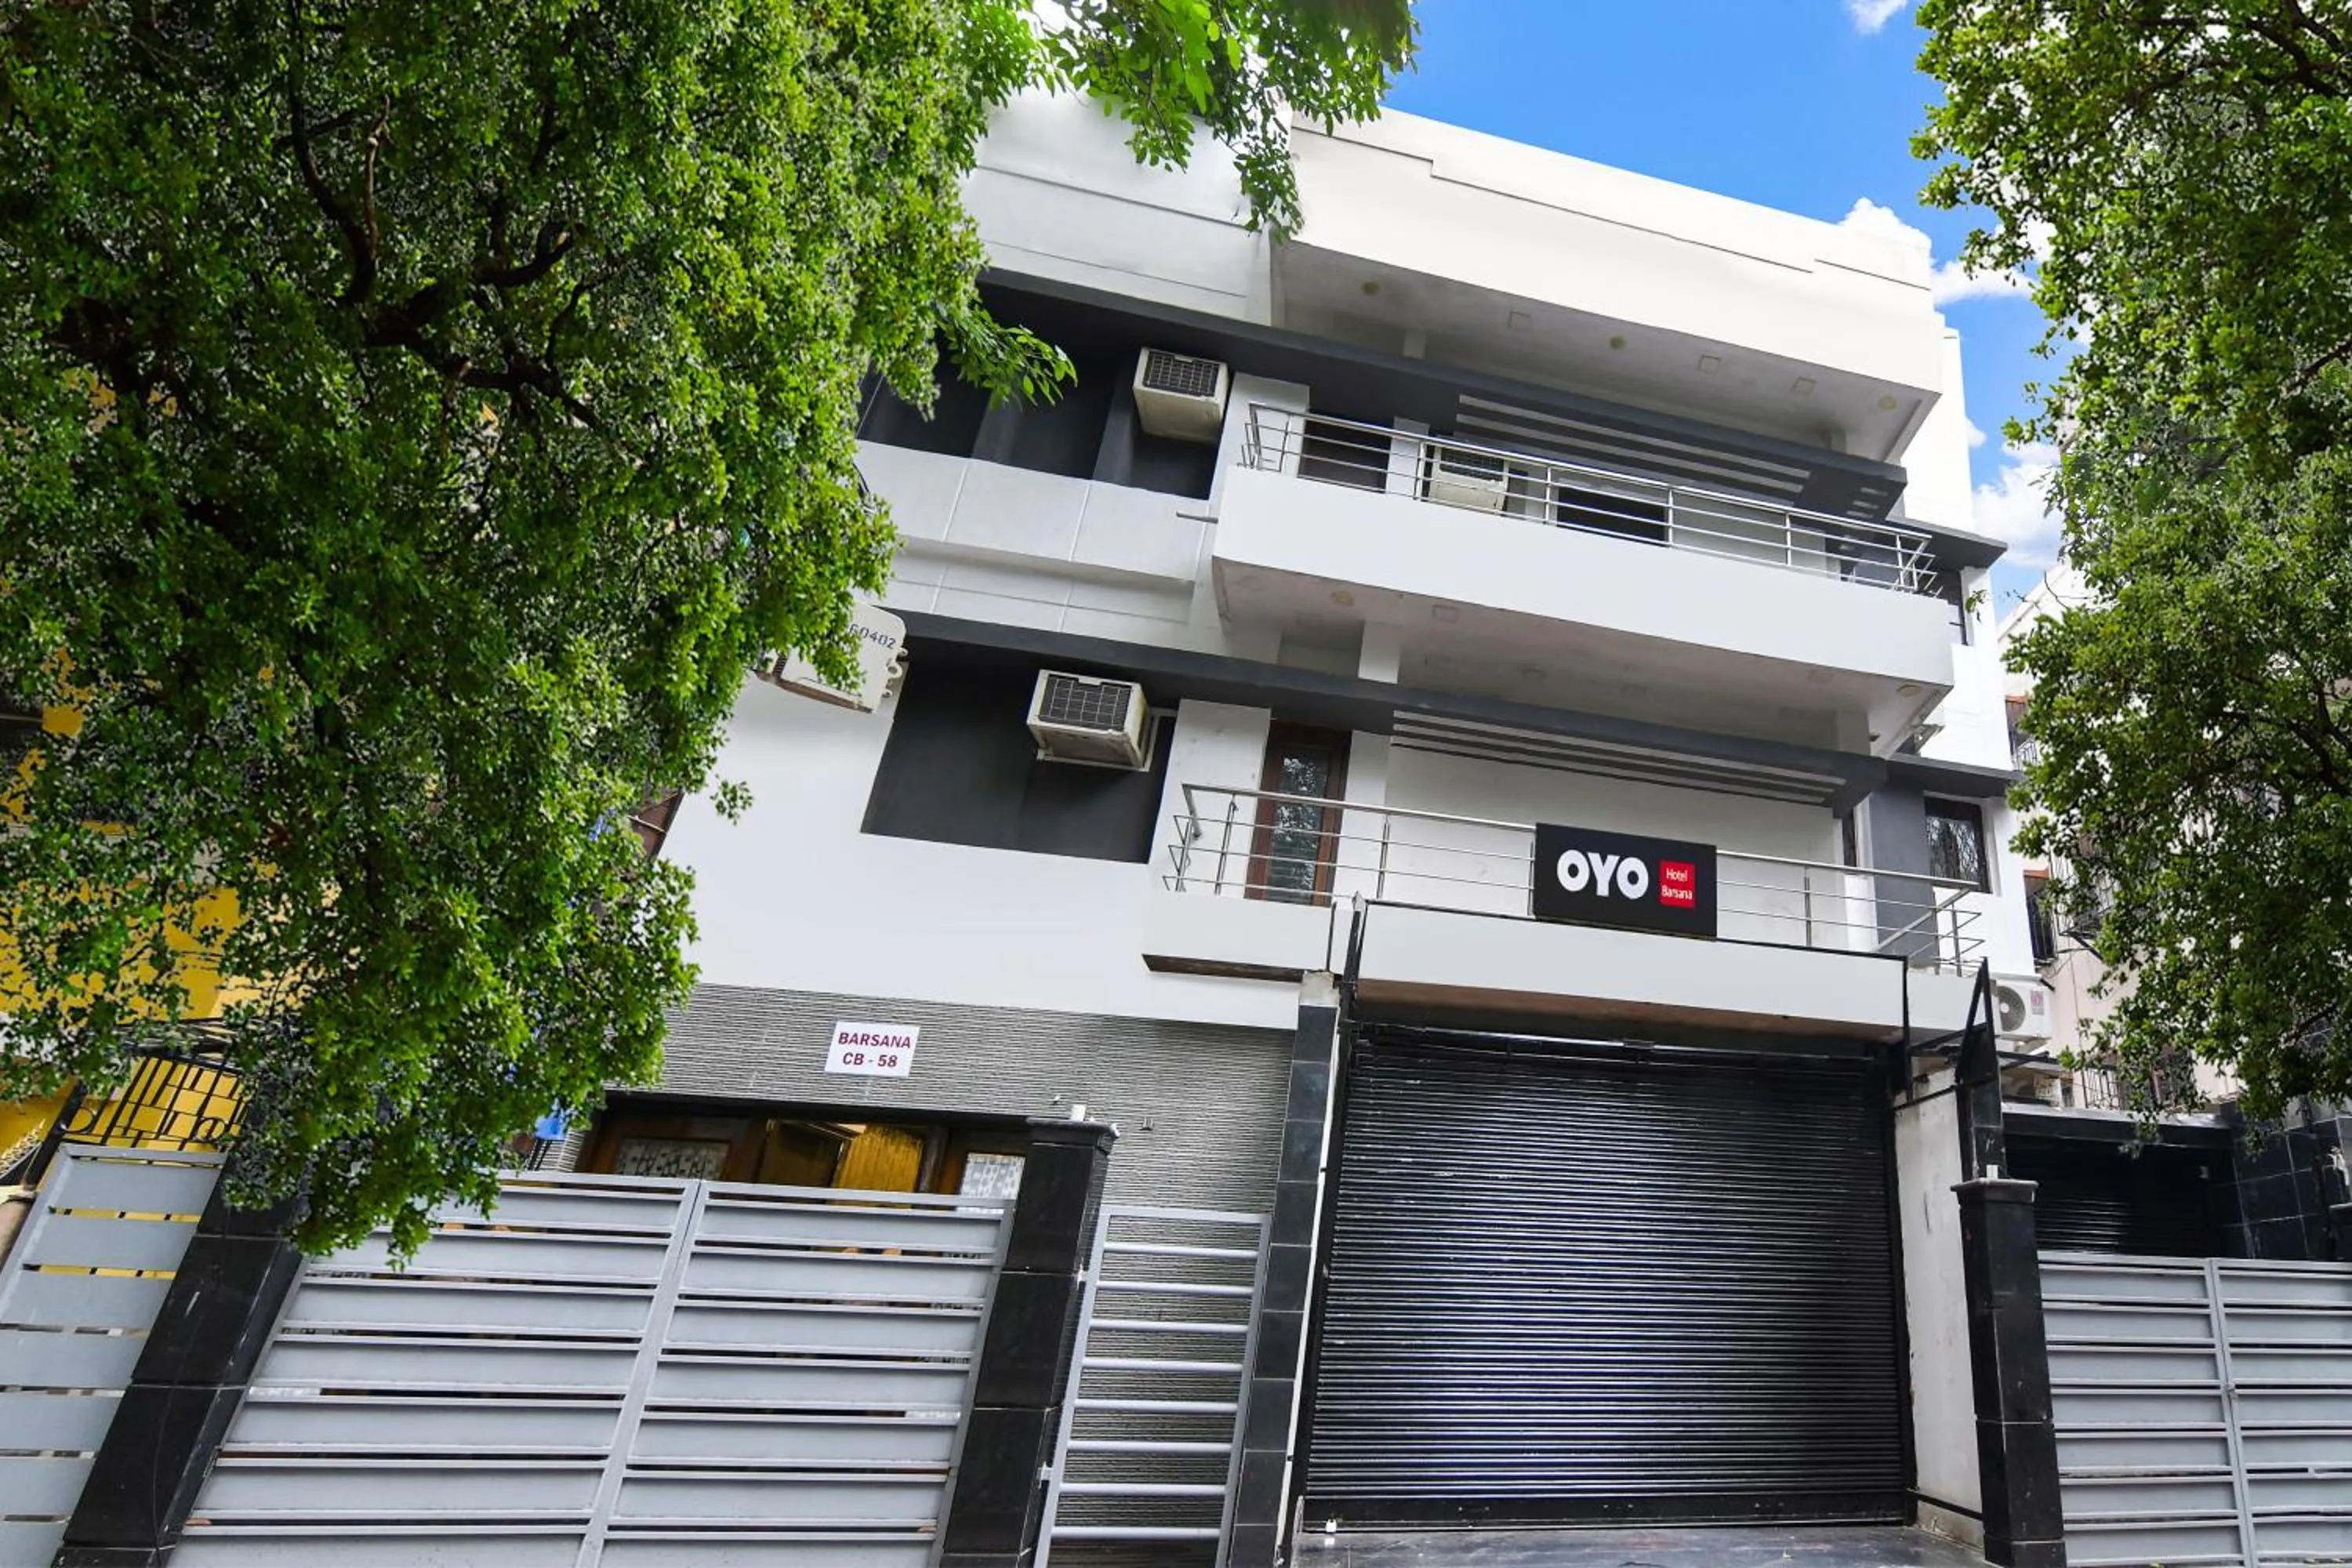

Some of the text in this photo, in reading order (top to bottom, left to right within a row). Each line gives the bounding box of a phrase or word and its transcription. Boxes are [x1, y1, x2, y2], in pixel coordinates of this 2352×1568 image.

[1557, 849, 1649, 899] OYO
[1666, 868, 1688, 883] Hotel
[1661, 885, 1693, 901] Barsana
[838, 1033, 911, 1048] BARSANA
[843, 1052, 865, 1065] CB
[877, 1054, 898, 1067] 58
